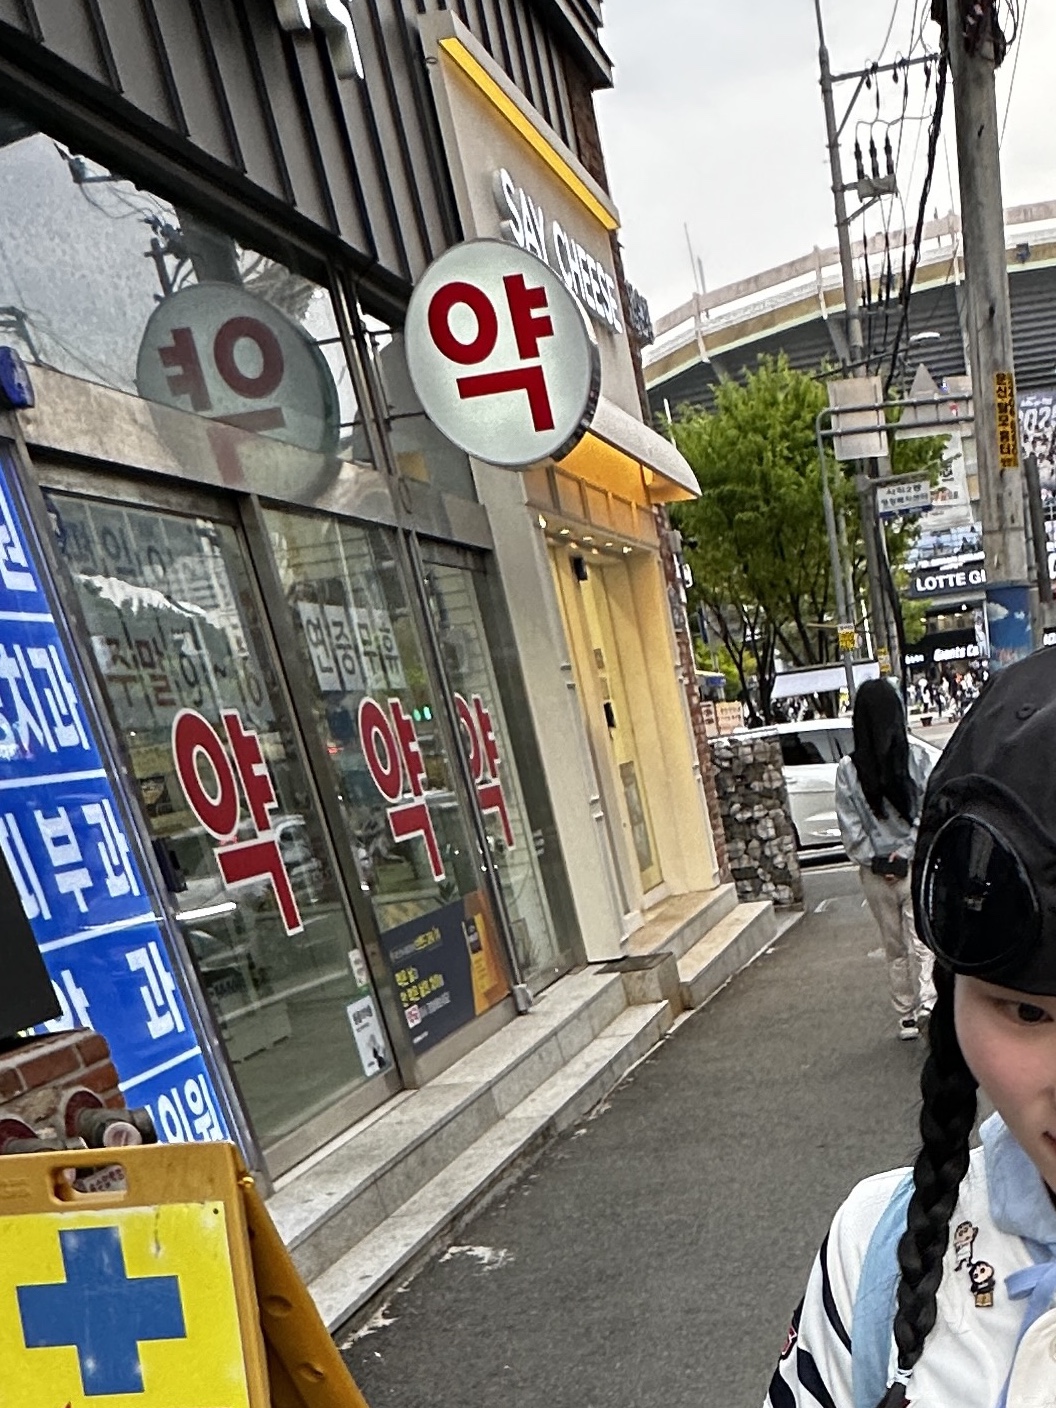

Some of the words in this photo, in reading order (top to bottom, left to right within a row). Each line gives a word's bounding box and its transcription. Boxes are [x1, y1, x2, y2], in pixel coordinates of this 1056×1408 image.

[500, 168, 550, 265] SAY
[552, 220, 623, 334] CHEESE
[428, 273, 556, 432] 약
[916, 571, 967, 592] LOTTE
[172, 707, 304, 936] 약
[358, 697, 446, 882] 약
[453, 692, 516, 851] 약
